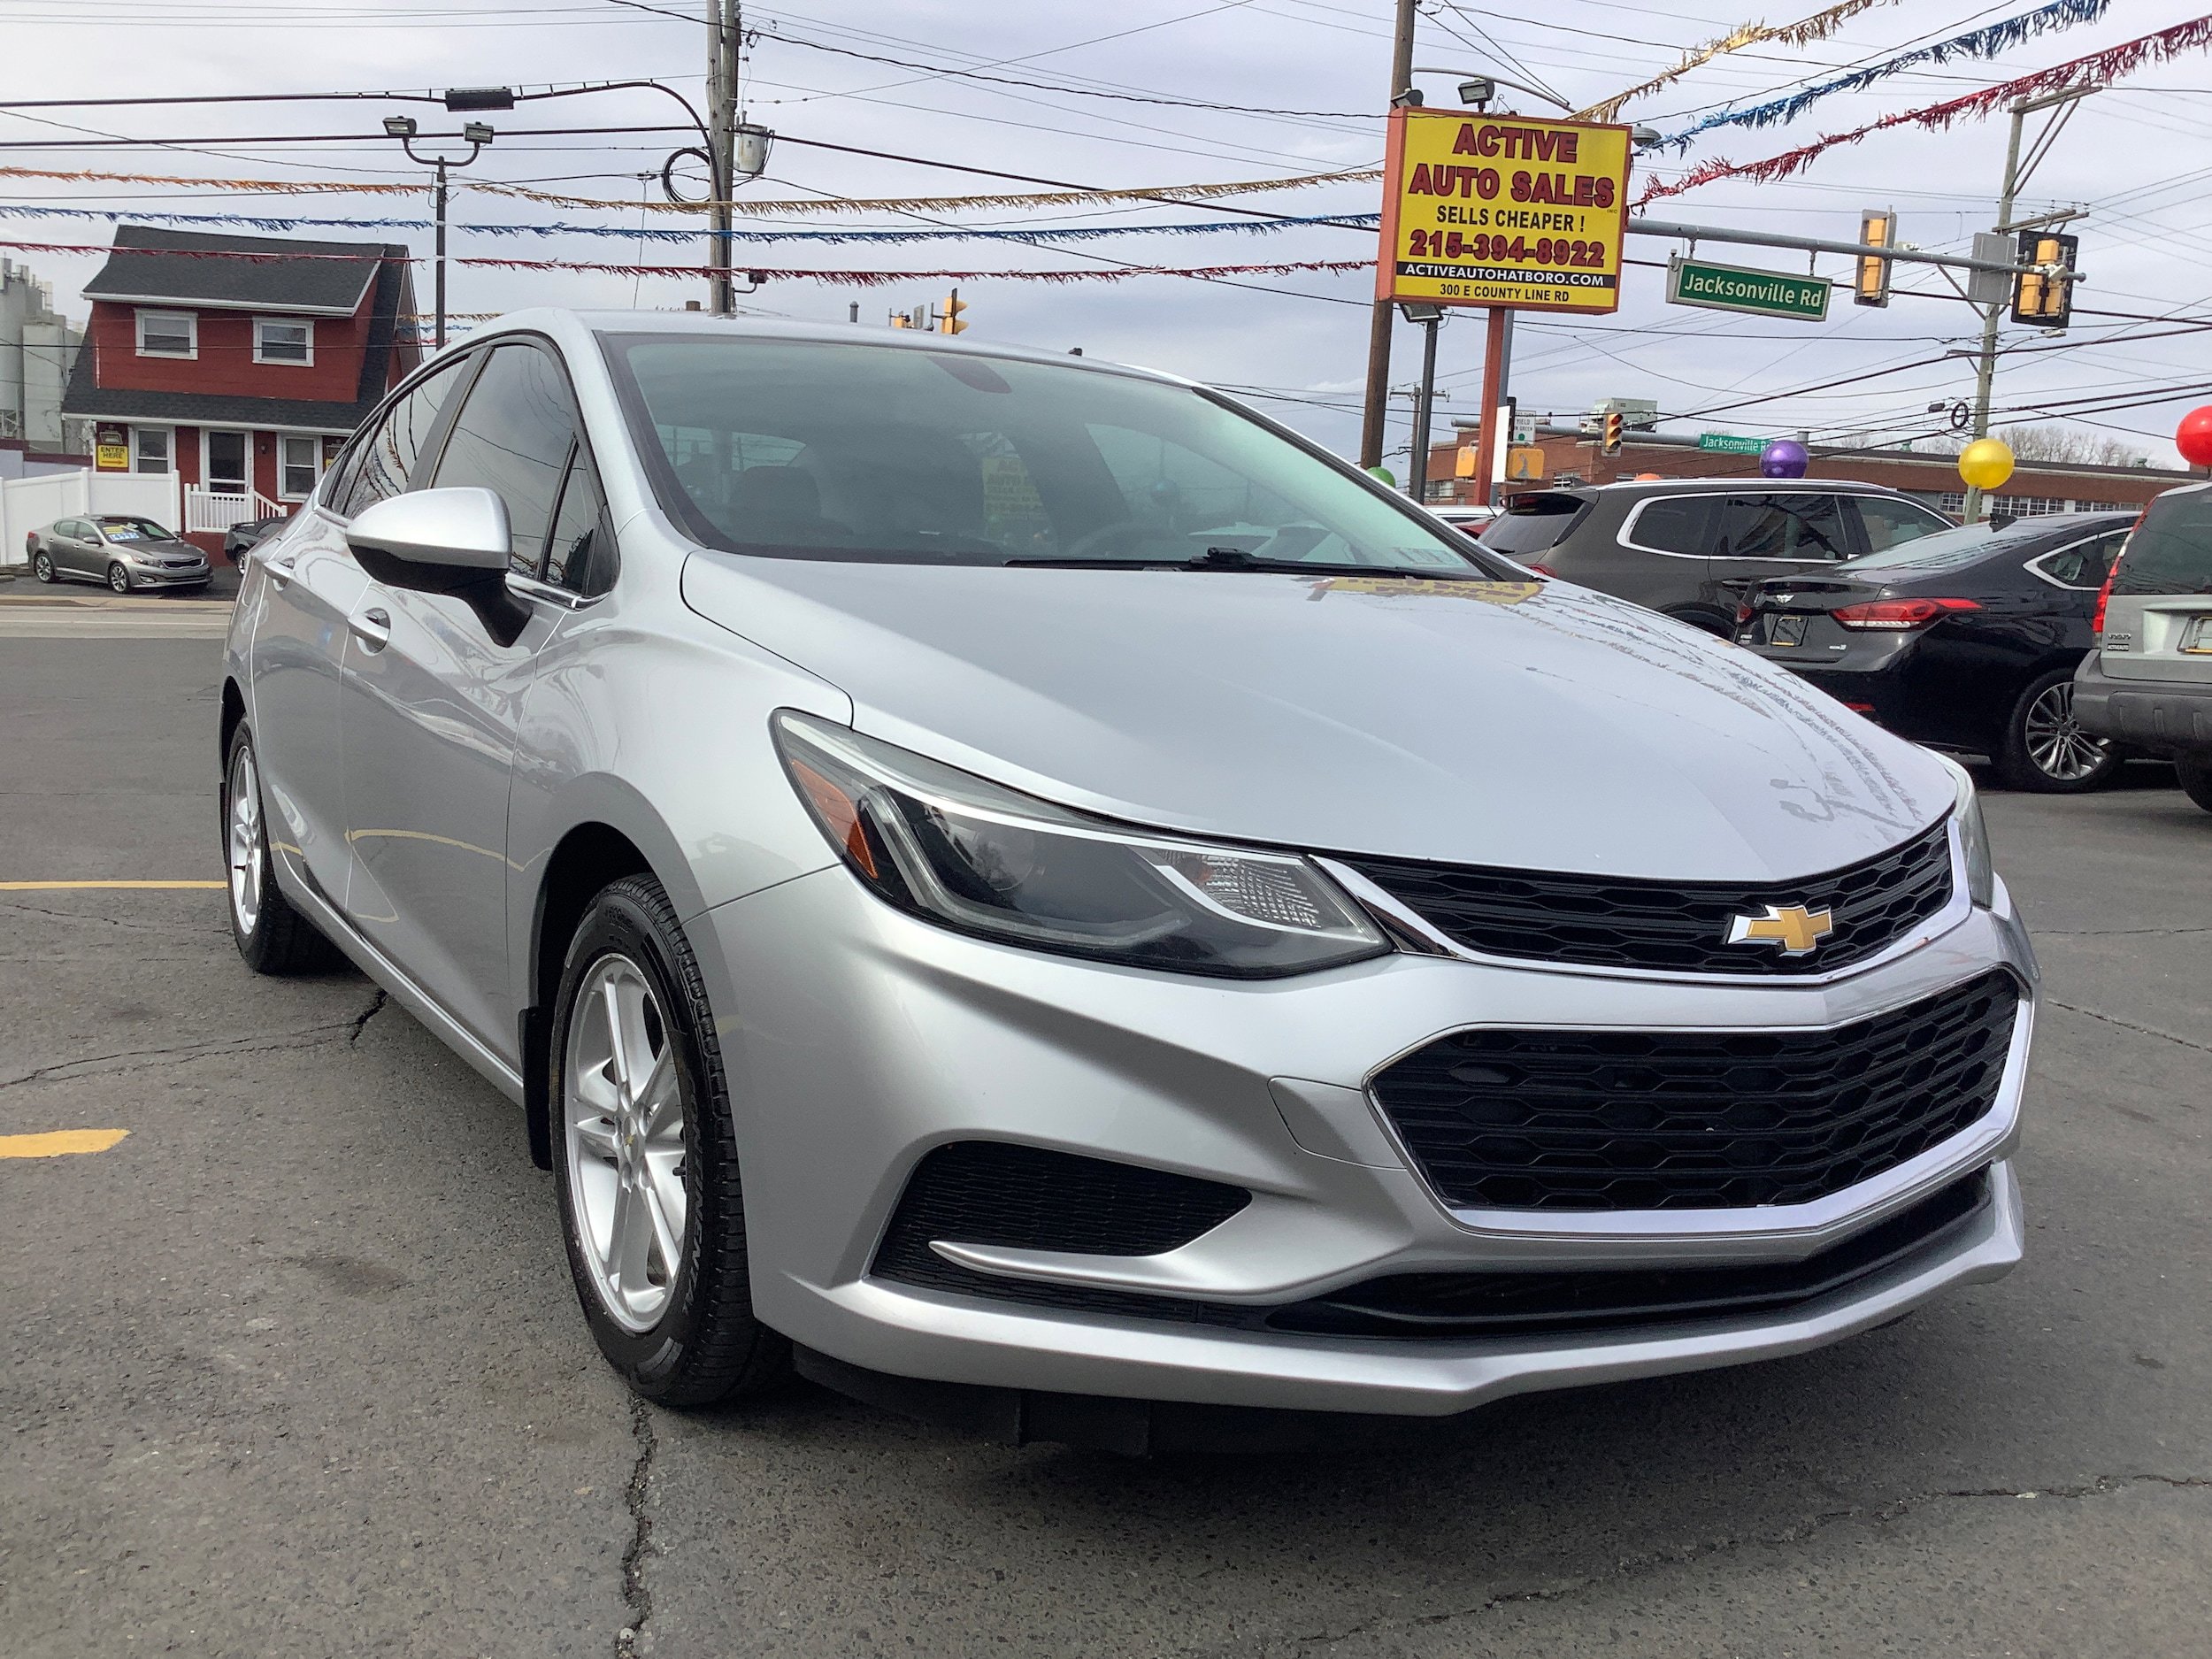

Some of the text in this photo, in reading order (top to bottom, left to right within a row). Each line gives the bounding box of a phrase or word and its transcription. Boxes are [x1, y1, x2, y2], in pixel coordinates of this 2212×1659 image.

[1452, 123, 1578, 164] ACTIVE
[1408, 163, 1615, 208] AUTO SALES
[1437, 205, 1585, 232] SELLS CHEAPER !
[1409, 228, 1605, 267] 215-394-8922
[1405, 264, 1604, 287] ACTIVEAUTOHATBORO.COM
[1684, 273, 1823, 308] Jacksonville Rd
[1440, 283, 1570, 302] 300 E COUNTY LINE RD
[1703, 436, 1759, 451] Jacksonville
